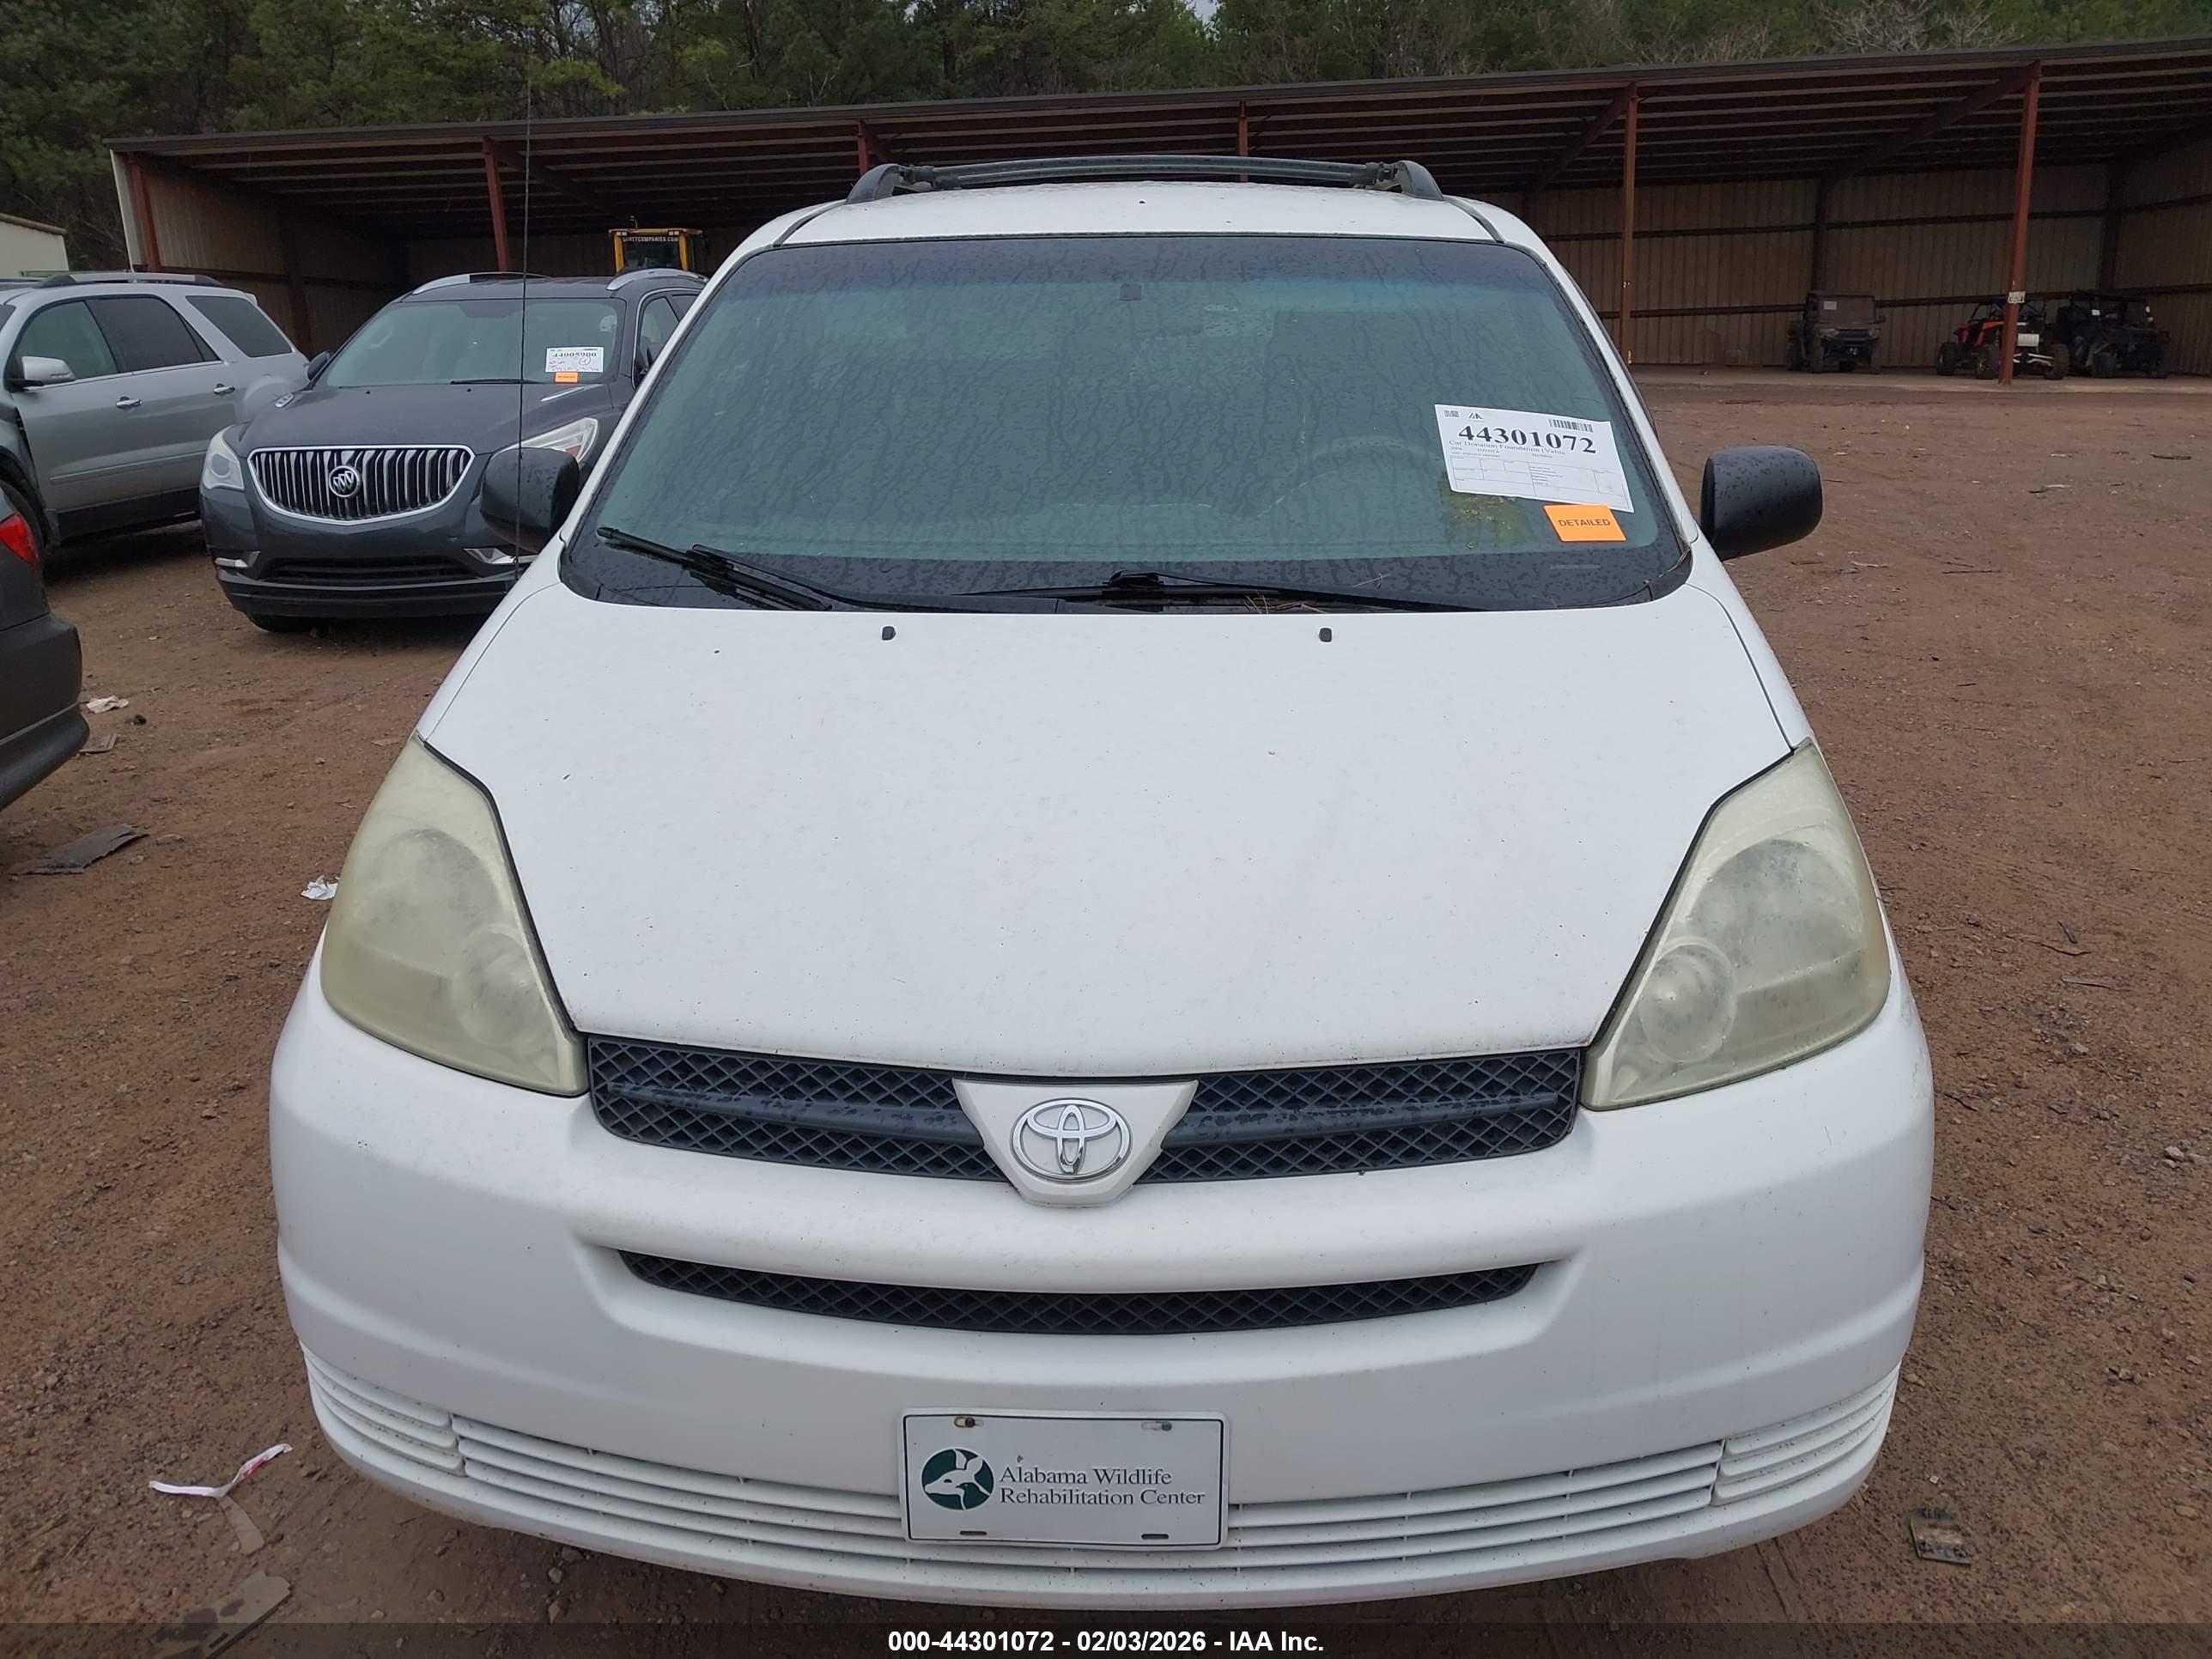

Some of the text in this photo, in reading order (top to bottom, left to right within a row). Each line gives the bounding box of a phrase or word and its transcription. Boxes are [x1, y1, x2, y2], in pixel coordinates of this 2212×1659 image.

[1458, 425, 1596, 454] 44301072
[1499, 444, 1540, 453] Foundation
[1558, 518, 1611, 527] DETAILED
[1000, 1466, 1173, 1485] Alabama Wildlife
[1000, 1487, 1206, 1505] Rehabilitation Center
